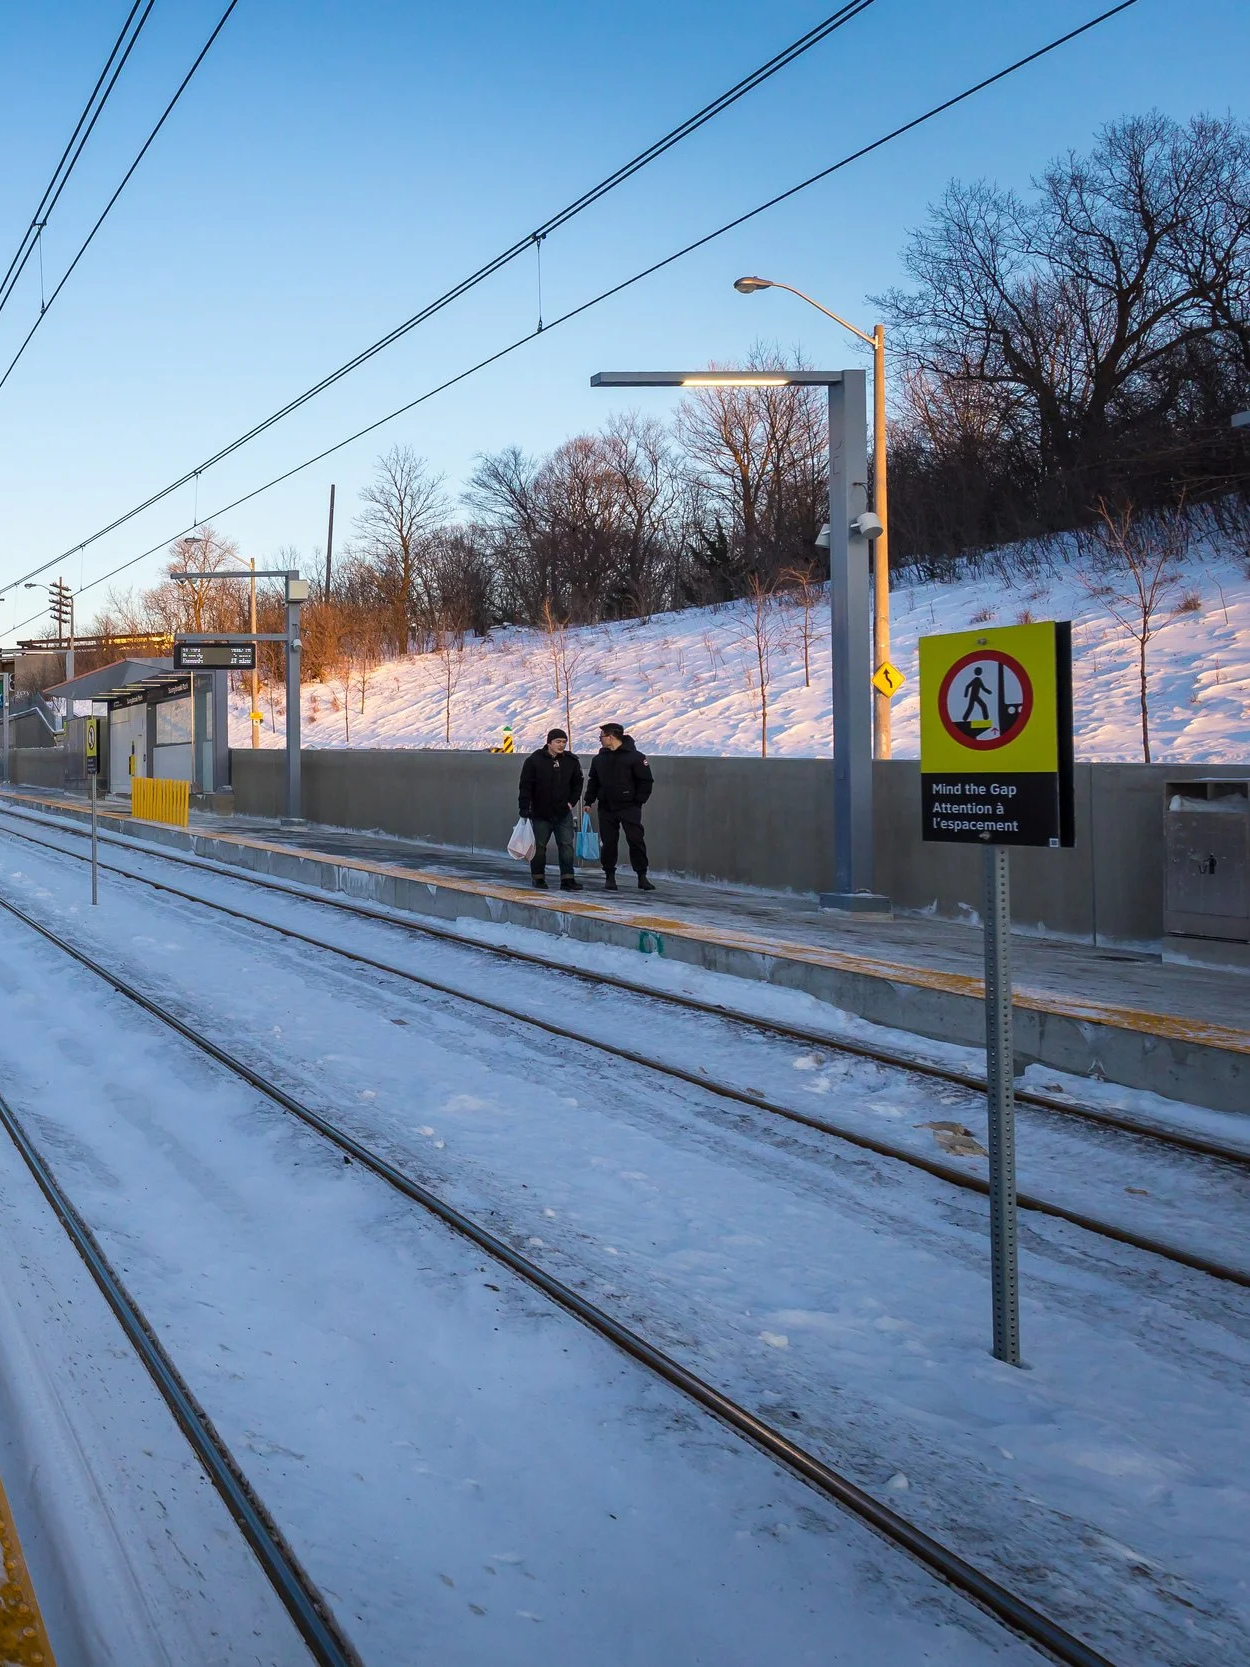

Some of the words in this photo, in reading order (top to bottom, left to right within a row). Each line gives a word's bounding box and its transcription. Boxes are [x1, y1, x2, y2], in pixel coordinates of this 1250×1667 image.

[932, 783, 961, 795] Mind
[964, 783, 986, 795] the
[990, 783, 1017, 798] Gap
[932, 802, 992, 814] Attention
[996, 802, 1004, 815] à
[933, 817, 1019, 832] l'espacement
